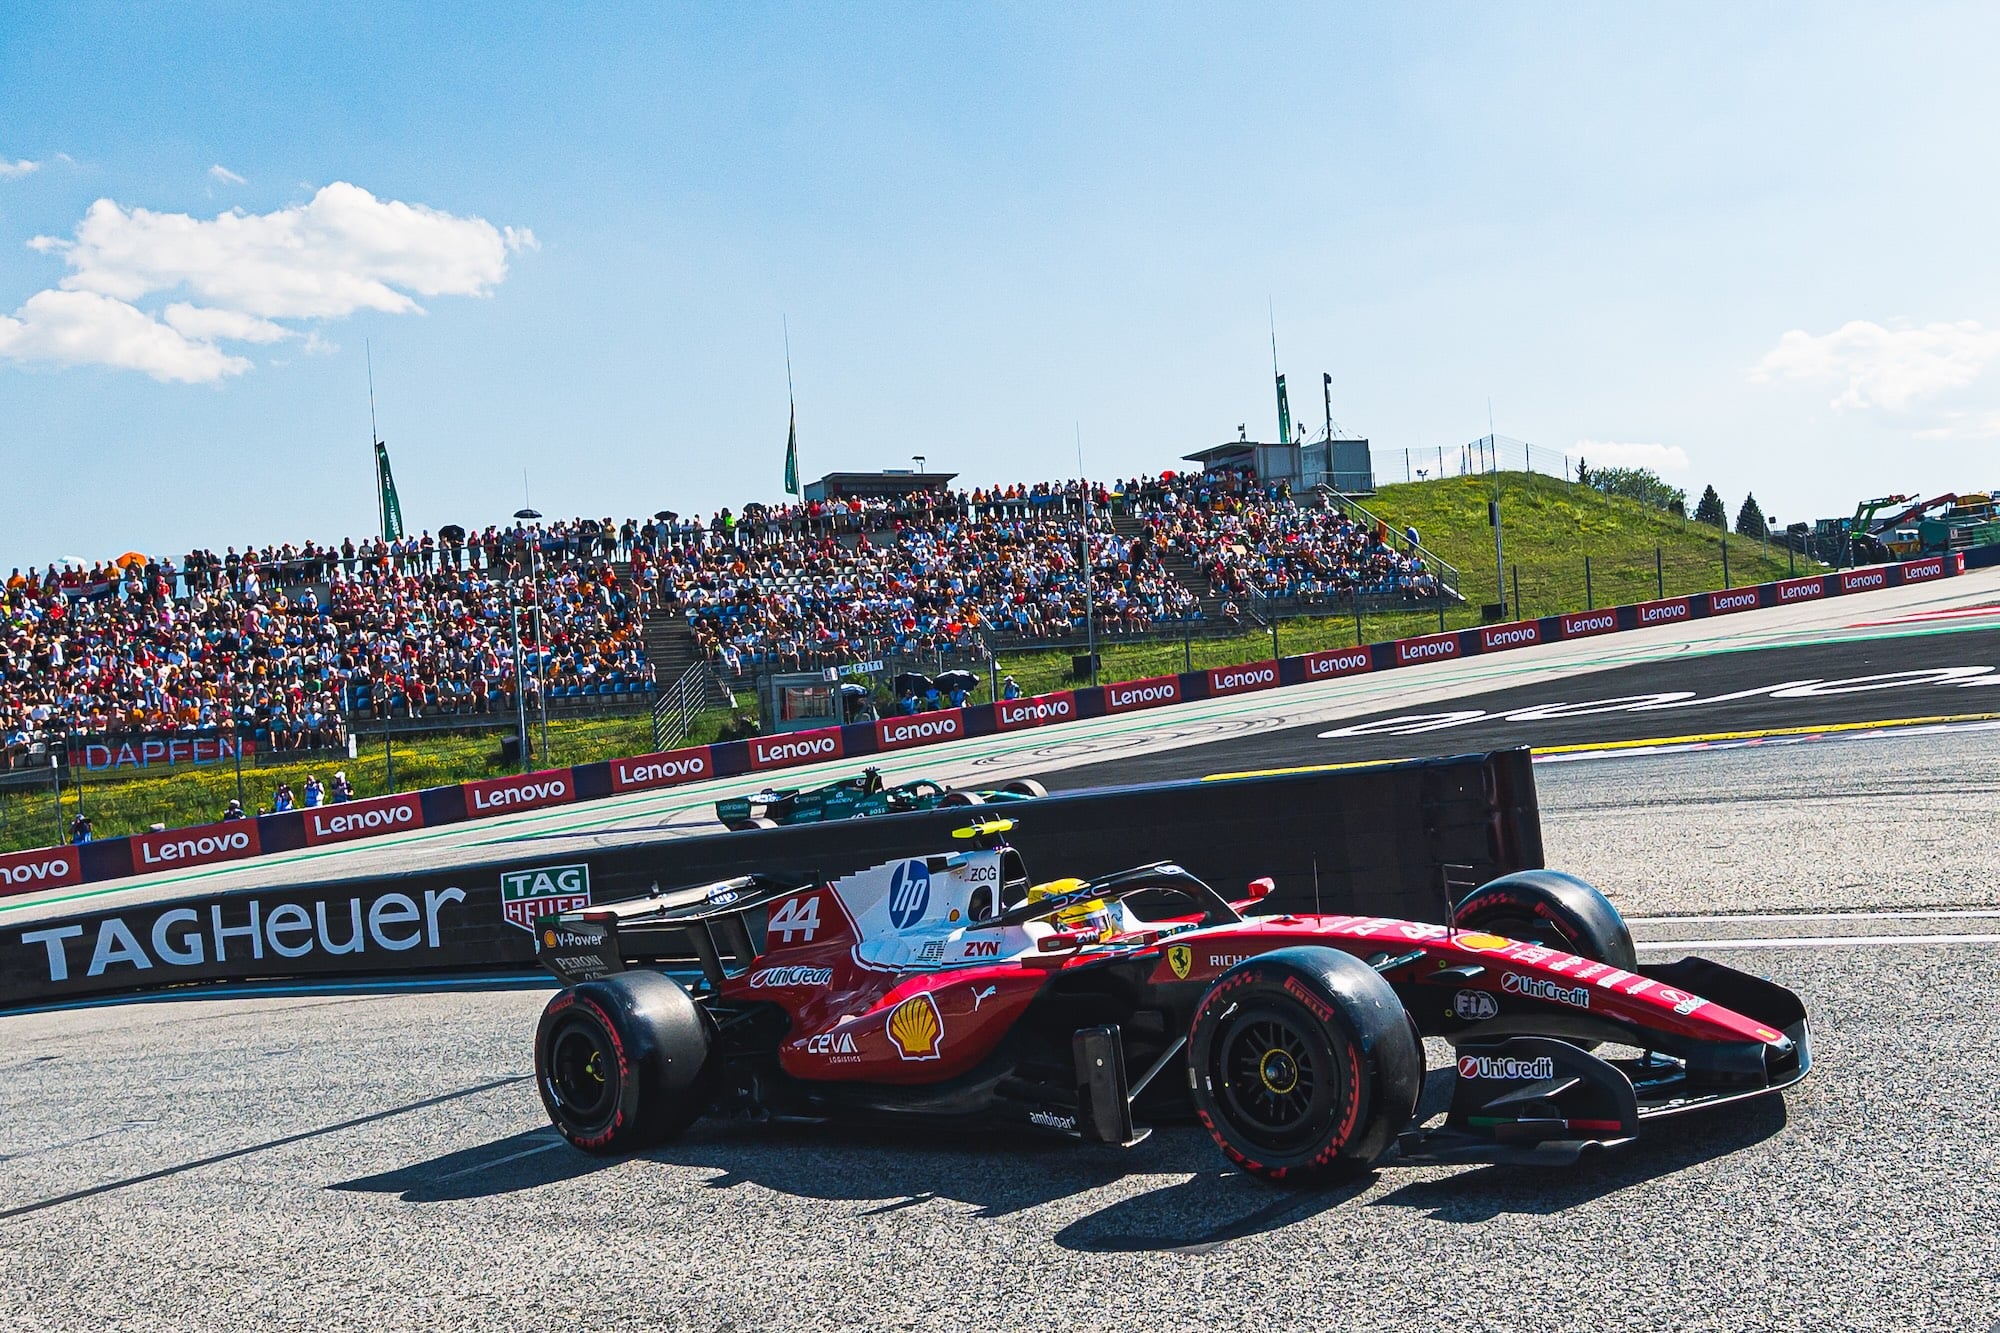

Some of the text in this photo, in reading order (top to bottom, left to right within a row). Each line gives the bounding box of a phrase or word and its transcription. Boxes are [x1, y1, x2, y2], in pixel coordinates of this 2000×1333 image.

[1844, 573, 1883, 589] Lenovo
[1904, 564, 1941, 580] Lenovo
[1713, 593, 1756, 610] Lenovo
[1780, 583, 1821, 599] Lenovo
[1641, 604, 1686, 622] Lenovo
[1566, 615, 1614, 634] Lenovo
[1486, 627, 1536, 647] Lenovo
[1401, 640, 1455, 660] Lenovo
[1310, 654, 1367, 675] Lenovo
[1214, 668, 1275, 690] Lenovo
[1110, 683, 1174, 707] Lenovo
[1002, 700, 1070, 724] Lenovo
[883, 718, 957, 743] Lenovo
[85, 737, 243, 771] DAPFEN
[757, 737, 835, 763] Lenovo
[619, 757, 704, 785] Lenovo
[474, 780, 566, 809] Lenovo
[314, 805, 413, 836] Lenovo
[143, 831, 249, 864] Lenovo
[508, 870, 581, 897] TAG
[892, 860, 928, 928] hp
[768, 897, 820, 942] 44
[556, 933, 602, 947] V-Power
[1075, 930, 1099, 943] ZYN
[964, 941, 1000, 957] ZYN
[555, 955, 604, 970] PERONI
[1210, 955, 1250, 967] RICH
[1284, 976, 1335, 1022] PIRELLI
[1520, 976, 1589, 1008] UniCredit
[1479, 1057, 1553, 1079] UniCredit
